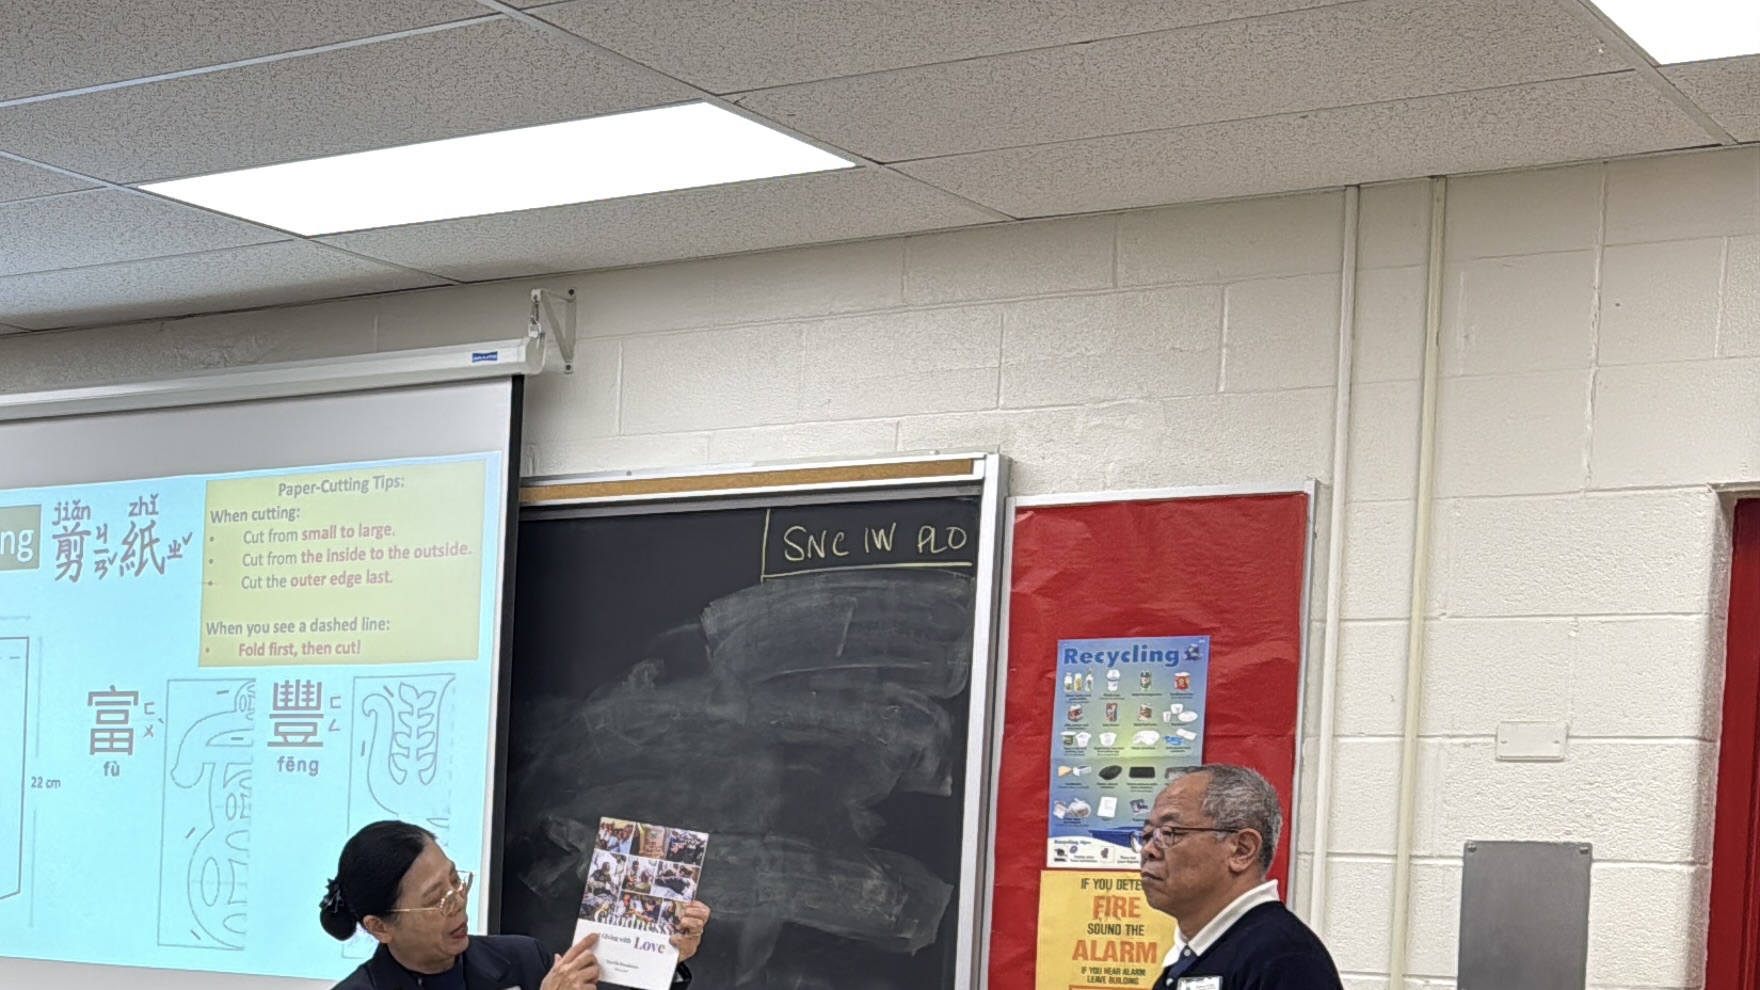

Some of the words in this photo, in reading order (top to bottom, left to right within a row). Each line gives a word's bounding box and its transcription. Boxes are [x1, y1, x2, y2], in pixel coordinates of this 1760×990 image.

[278, 477, 369, 498] Paper-Cutting
[373, 475, 405, 491] Tips:
[52, 500, 91, 526] jiǎn
[128, 493, 159, 517] zhǐ
[210, 509, 248, 524] When
[251, 506, 300, 522] cutting:
[243, 530, 264, 544] Cut
[268, 527, 298, 543] from
[301, 525, 337, 541] small
[340, 526, 354, 539] to
[358, 523, 395, 541] large.
[783, 525, 850, 561] SNC
[242, 553, 263, 567] Cut
[267, 550, 297, 566] from
[301, 549, 323, 564] the
[326, 547, 366, 563] inside
[370, 547, 384, 561] to
[388, 544, 410, 560] the
[414, 541, 472, 559] outside.
[241, 575, 263, 589] Cut
[266, 573, 287, 588] the
[290, 573, 326, 588] outer
[330, 570, 362, 588] edge
[366, 569, 393, 584] last.
[206, 621, 242, 636] When
[247, 623, 270, 637] you
[273, 621, 295, 634] see
[299, 621, 307, 633] a
[310, 617, 357, 632] dashed
[361, 617, 390, 631] line:
[238, 642, 265, 657] Fold
[269, 641, 298, 658] first,
[301, 641, 332, 656] then
[334, 640, 361, 655] cut!
[1063, 644, 1180, 668] Recycling
[87, 684, 139, 756] 富
[276, 756, 320, 777] fēng
[31, 776, 43, 789] 22
[45, 777, 61, 789] cm
[1081, 877, 1090, 890] IF
[1093, 878, 1113, 891] YOU
[1116, 878, 1143, 891] DETE
[1093, 895, 1141, 919] FIRE
[1087, 923, 1122, 935] SOUND
[1125, 924, 1145, 936] THE
[634, 937, 665, 953] Love
[1072, 939, 1158, 964] ALARM
